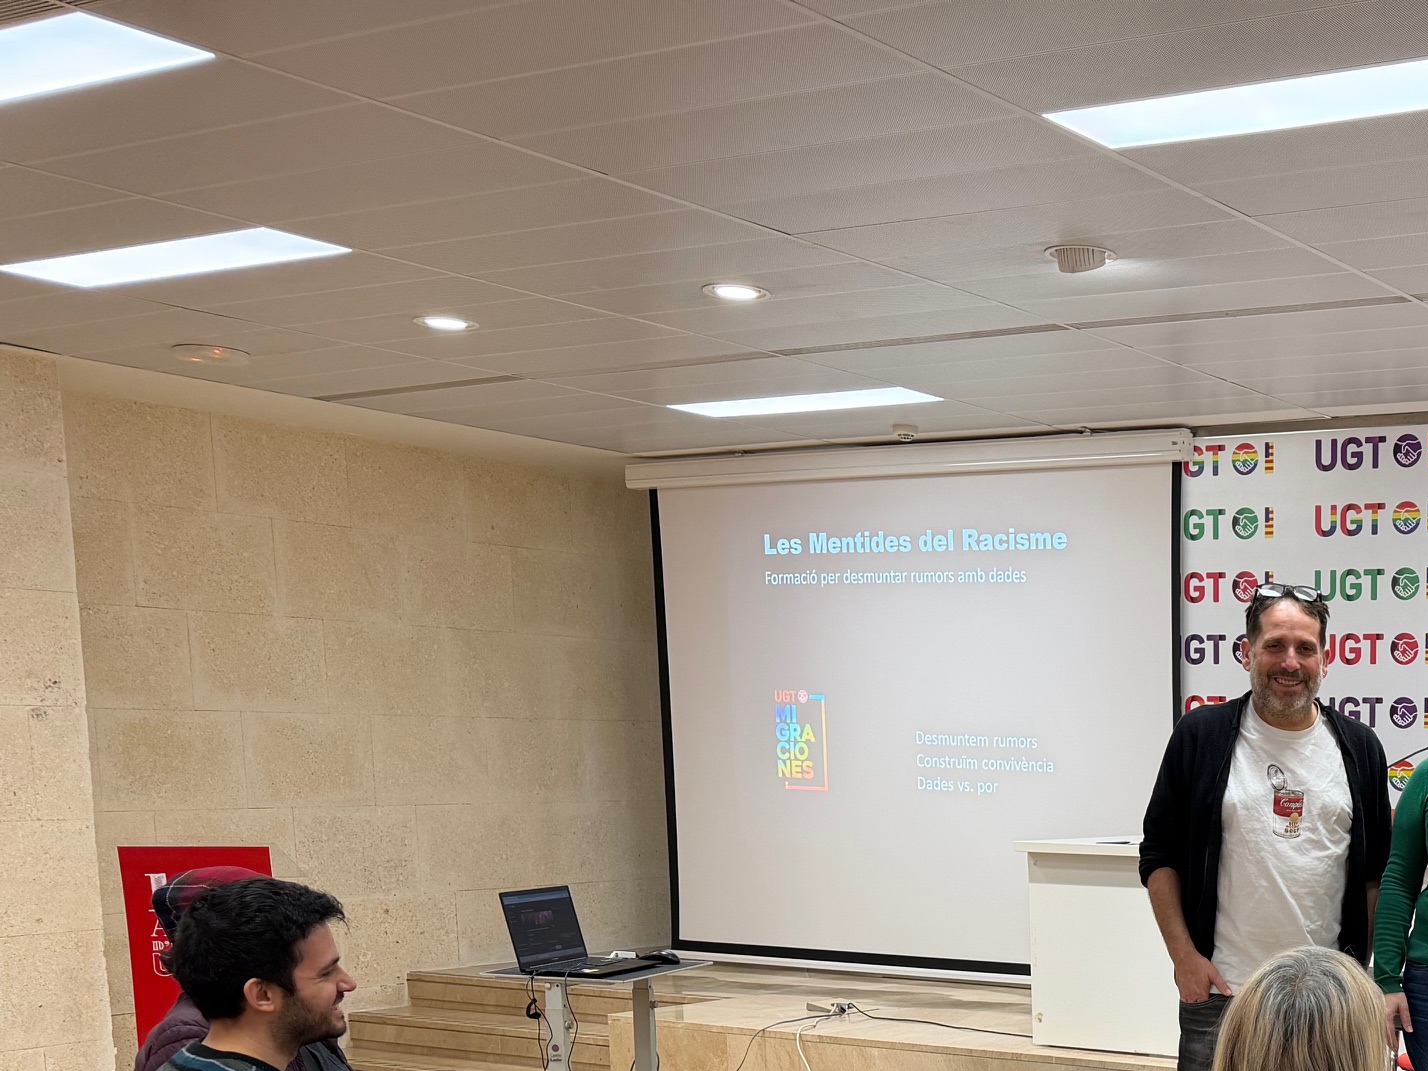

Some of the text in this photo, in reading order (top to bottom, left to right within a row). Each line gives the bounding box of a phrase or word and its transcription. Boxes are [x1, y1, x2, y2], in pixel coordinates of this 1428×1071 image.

[1183, 444, 1226, 478] GT
[1315, 435, 1387, 472] UGT
[1183, 508, 1226, 541] GT
[1314, 502, 1386, 537] UGT
[763, 527, 1068, 556] Les Mentides del Racisme
[764, 567, 1027, 588] Formació per desmuntar rumors amb dades
[1184, 571, 1227, 604] GT
[1314, 568, 1385, 602] UGT
[1184, 633, 1227, 665] GT
[774, 690, 797, 703] UGT
[775, 704, 797, 723] MI
[775, 723, 816, 743] GRA
[915, 730, 1038, 749] Desmuntem rumors
[776, 741, 809, 761] CIO
[777, 760, 815, 780] NES
[916, 753, 1054, 773] Construïm convivència
[917, 776, 998, 796] Dades vs. por
